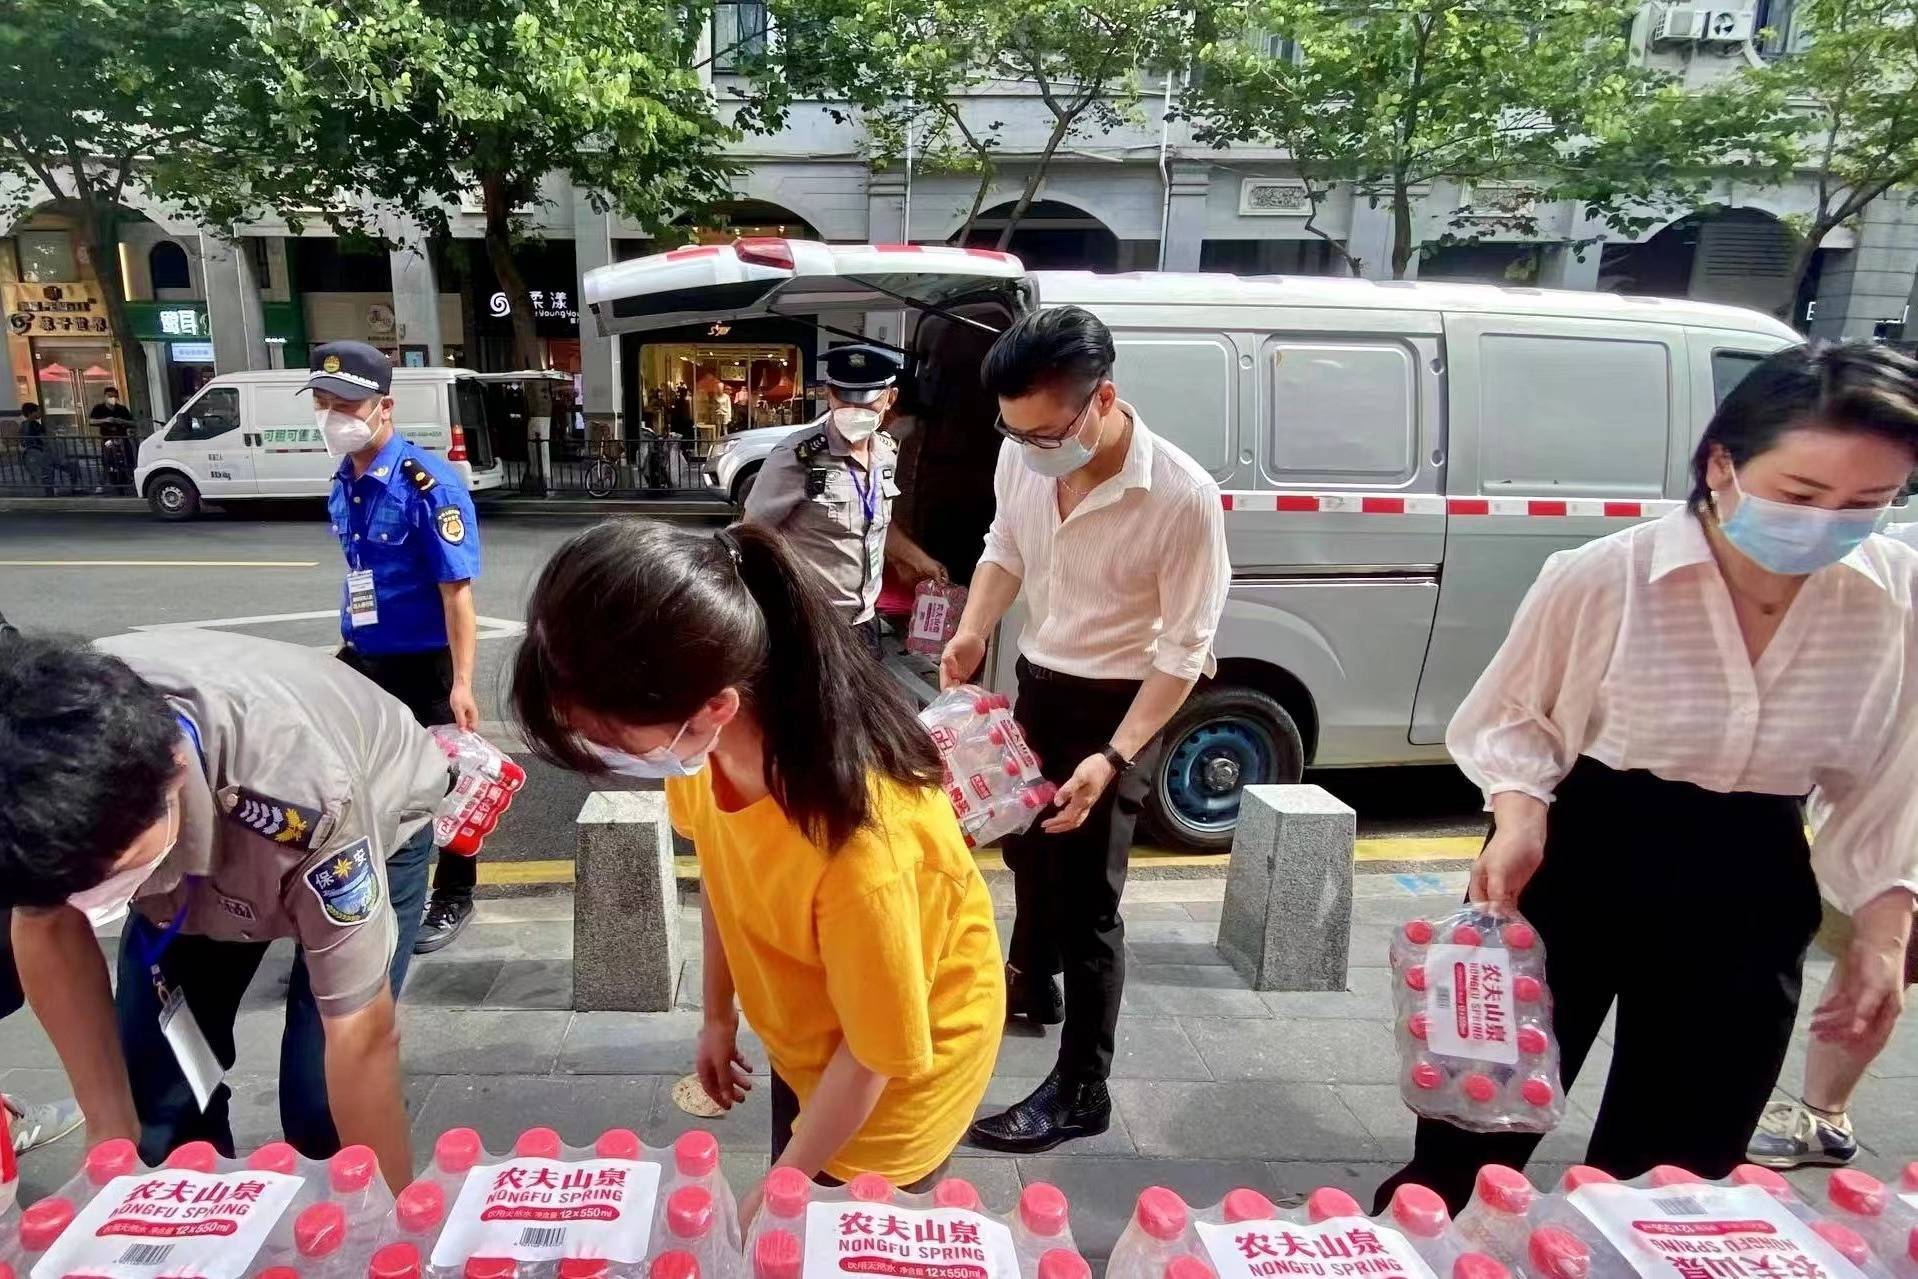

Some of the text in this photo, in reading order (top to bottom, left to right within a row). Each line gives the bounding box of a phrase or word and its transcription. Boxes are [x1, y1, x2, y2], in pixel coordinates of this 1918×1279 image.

[315, 848, 367, 890] 保 安
[1481, 963, 1507, 1042] 农夫山泉
[492, 1167, 627, 1190] 农夫山泉
[123, 1179, 267, 1203] 农夫山泉
[487, 1189, 624, 1204] NONGFU SPRING
[182, 1203, 250, 1218] SPRING
[838, 1211, 983, 1246] 农夫山泉
[839, 1239, 985, 1262] NONGFU SPRING
[1234, 1228, 1390, 1260] 农夫山泉
[1650, 1238, 1721, 1253] SPRING
[1248, 1257, 1404, 1277] NONGFU SPRING
